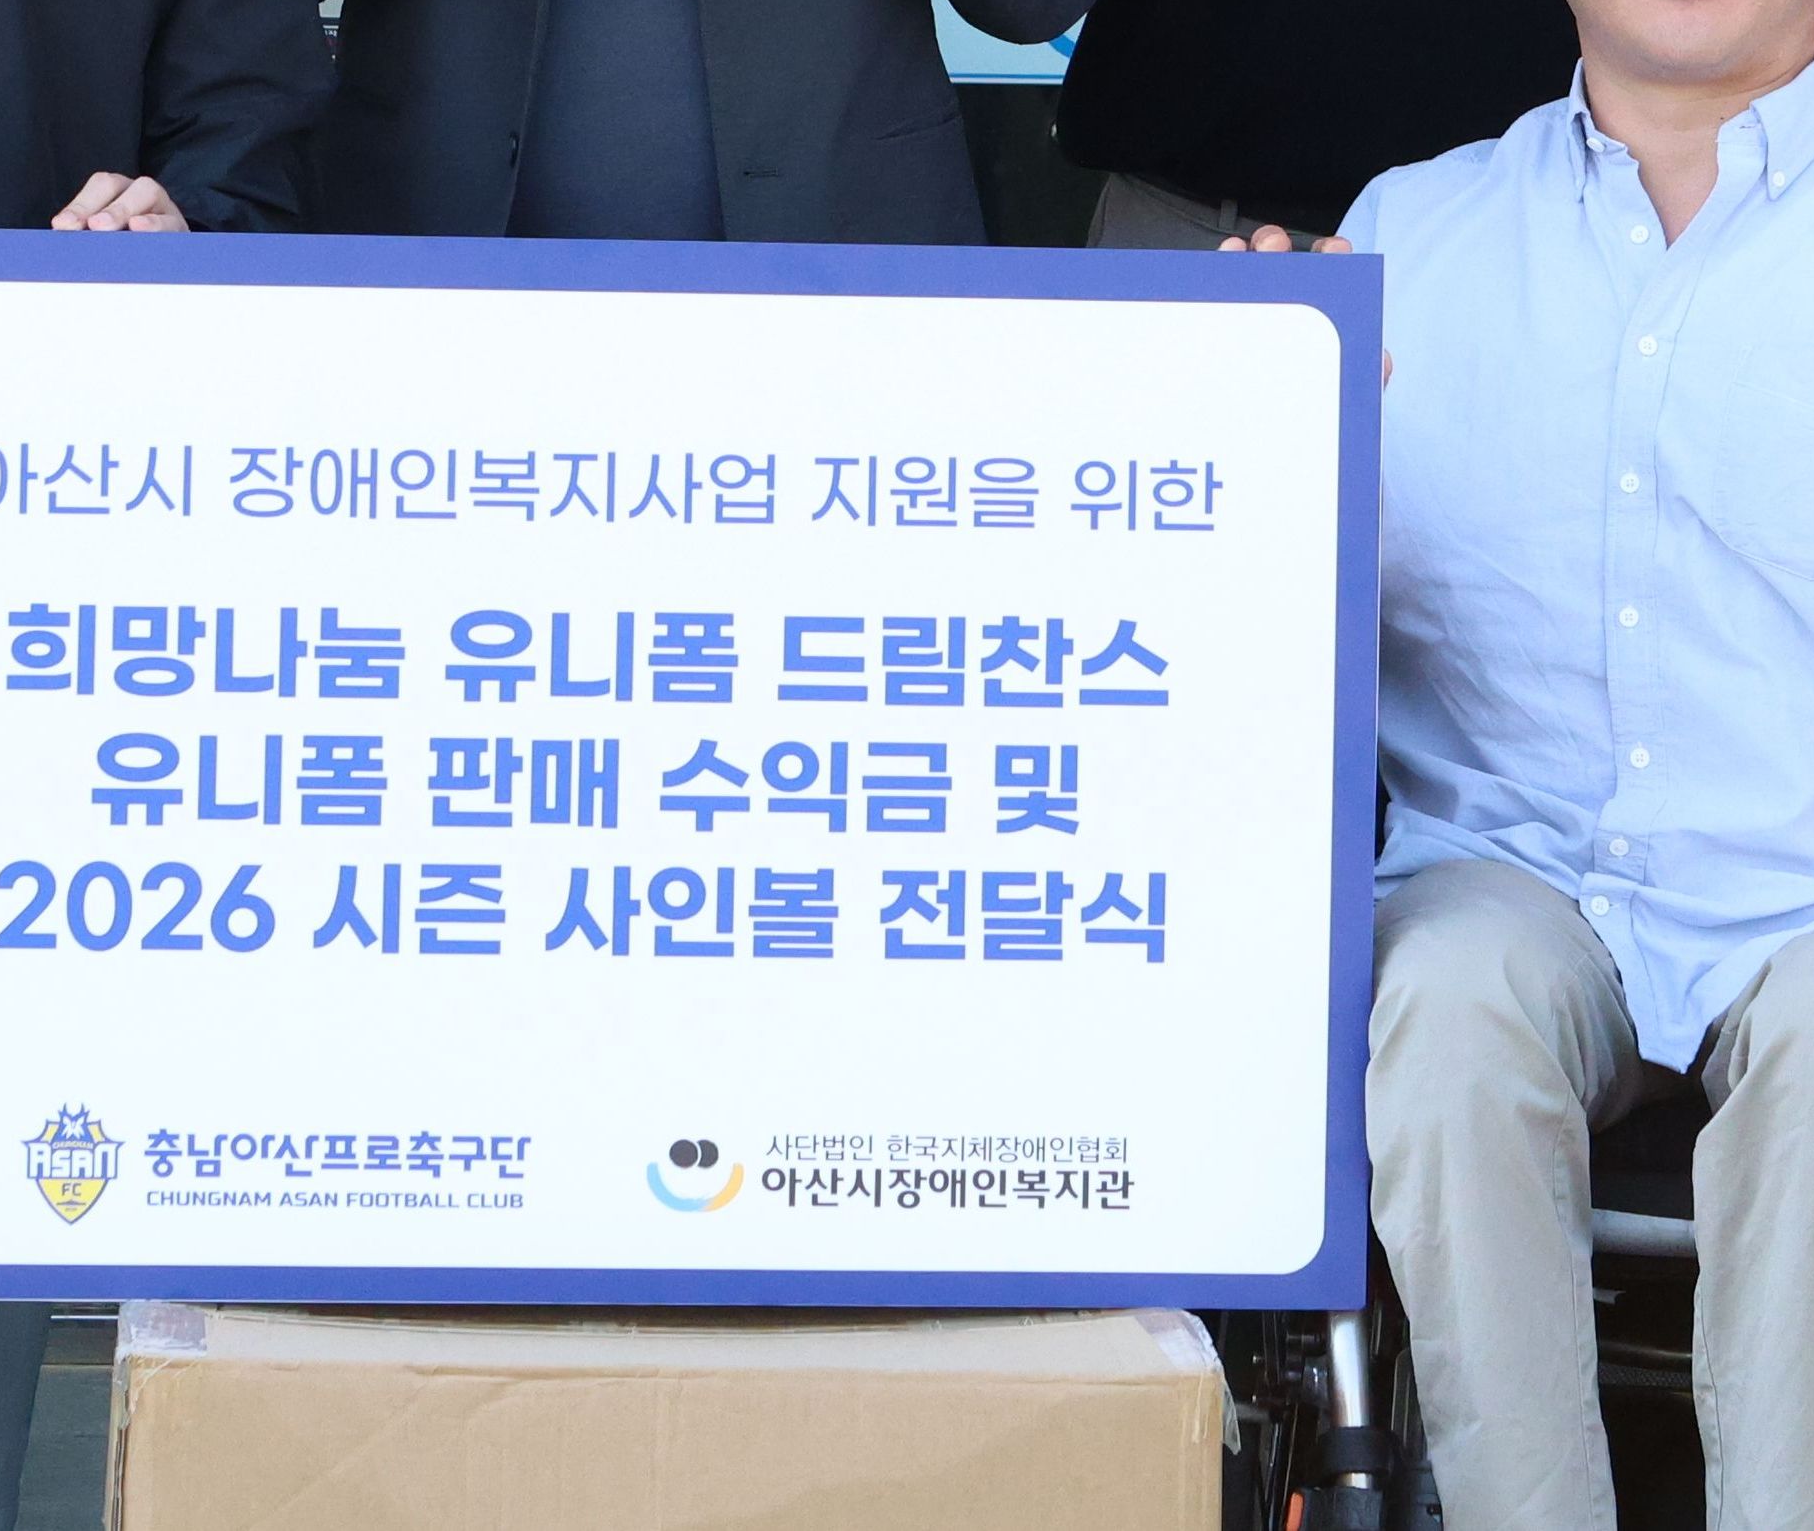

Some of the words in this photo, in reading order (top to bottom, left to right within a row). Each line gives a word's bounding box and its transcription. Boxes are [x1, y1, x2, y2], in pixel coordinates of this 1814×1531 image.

[230, 447, 775, 524] 장애인복지사업
[812, 456, 1039, 528] 지원을
[1071, 460, 1223, 531] 위한
[6, 603, 405, 699] 희망나눔
[445, 610, 738, 703] 유니폼
[778, 616, 1169, 708] 드림찬스
[92, 733, 387, 826] 유니폼
[428, 738, 619, 829] 판매
[660, 739, 952, 833] 수익금
[995, 745, 1079, 835] 및
[313, 864, 505, 955] 시즌
[545, 866, 839, 958] 사인볼
[880, 870, 1166, 963] 전달식
[28, 1142, 117, 1179] ASAN
[144, 1129, 531, 1179] 충남아산프로축구단
[766, 1134, 873, 1161] 사단법인
[887, 1135, 1128, 1164] 한국지체장애인협회
[62, 1183, 82, 1197] FC
[146, 1191, 272, 1207] CHUNGNAM
[280, 1192, 338, 1208] ASAN
[347, 1192, 460, 1209] FOOTBALL
[467, 1193, 524, 1209] CLUB
[761, 1167, 1135, 1210] 아산시장애인복지관
